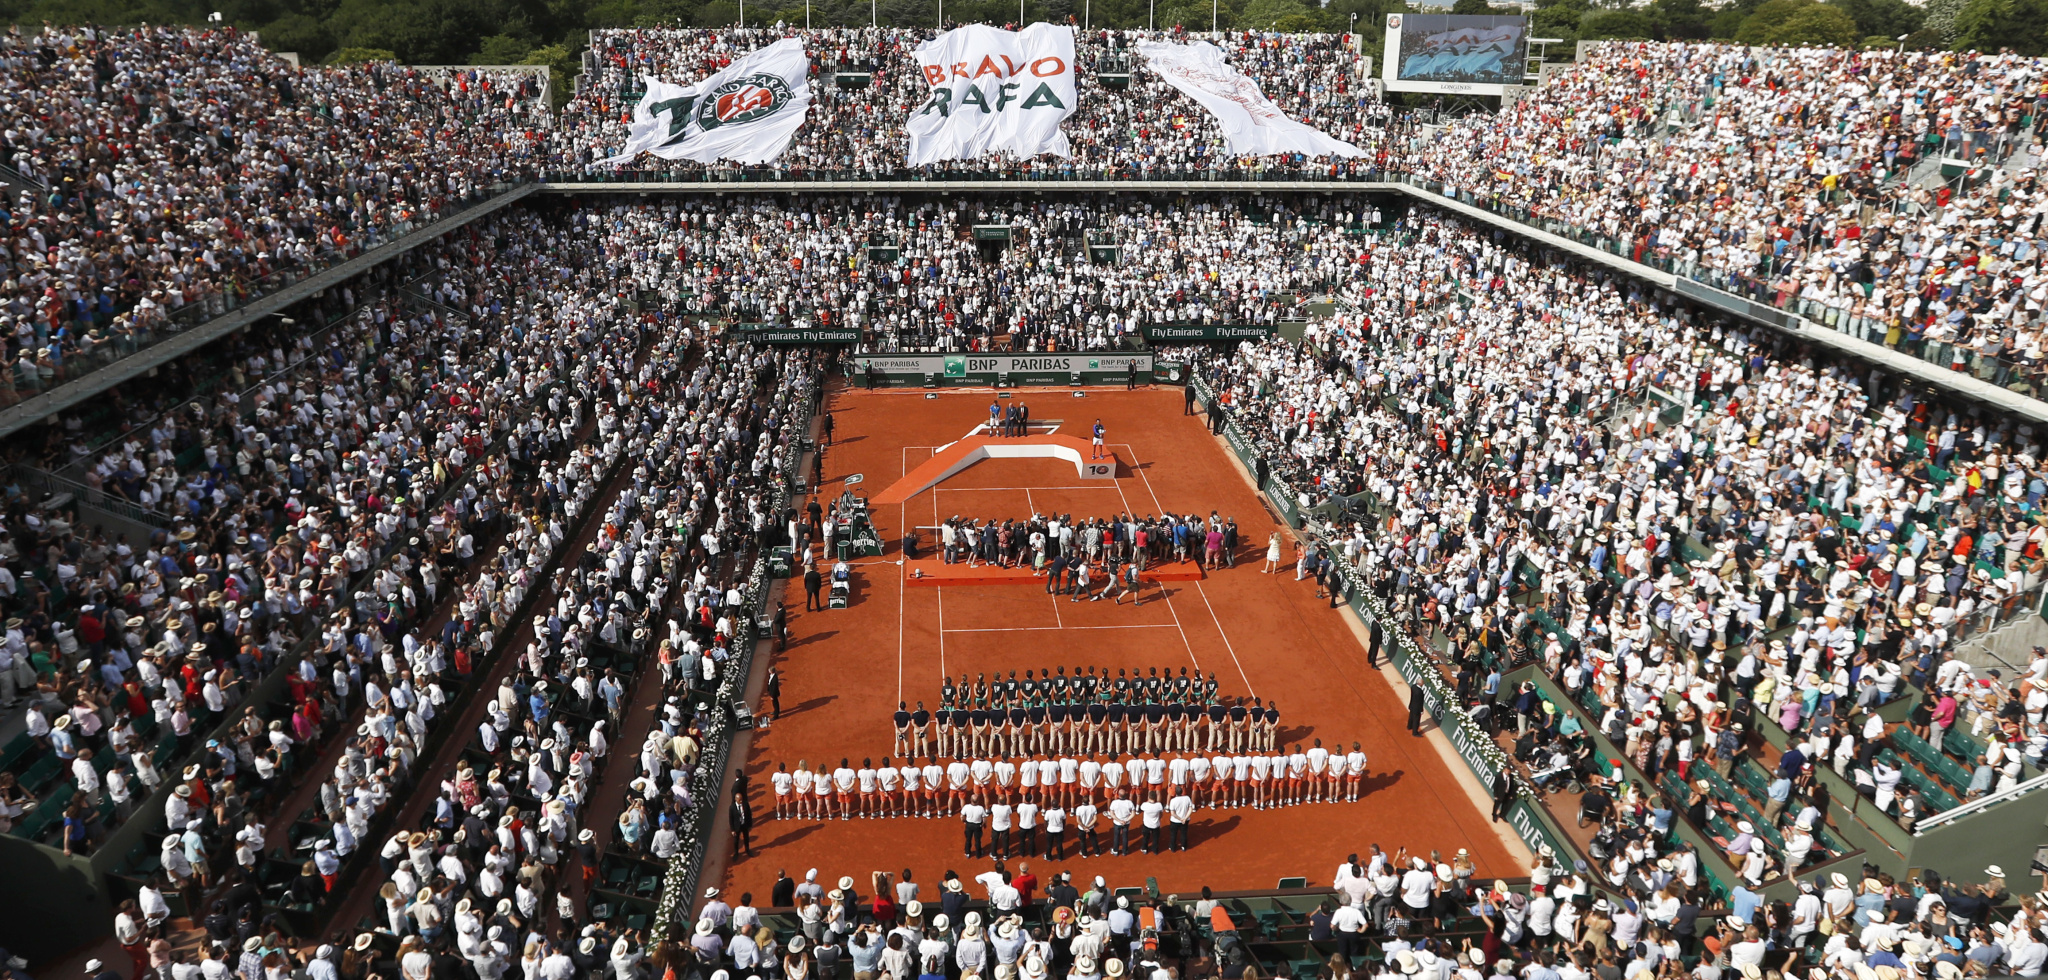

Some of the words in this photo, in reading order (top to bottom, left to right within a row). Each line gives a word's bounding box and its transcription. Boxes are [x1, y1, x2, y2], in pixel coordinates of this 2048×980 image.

[923, 54, 1066, 86] BRAVO
[921, 82, 1066, 117] RAFA
[747, 333, 762, 343] Fly
[762, 332, 800, 341] Emirates
[803, 331, 818, 341] Fly
[820, 331, 857, 340] Emirates
[1152, 328, 1166, 338] Fly
[1166, 328, 1204, 337] Emirates
[1216, 327, 1231, 338] Fly
[1231, 327, 1268, 337] Emirates
[890, 360, 920, 368] PARIBAS
[969, 359, 998, 371] BNP
[1011, 358, 1070, 370] PARIBAS
[1269, 484, 1291, 513] LONGINES
[852, 536, 876, 553] perrier
[1401, 658, 1417, 682] Fly
[710, 735, 729, 789] Emirates
[1452, 725, 1470, 754] Fly
[1465, 743, 1496, 789] Emirat
[705, 783, 719, 809] Fly
[1513, 806, 1535, 841] Fly
[680, 839, 703, 906] Emirates
